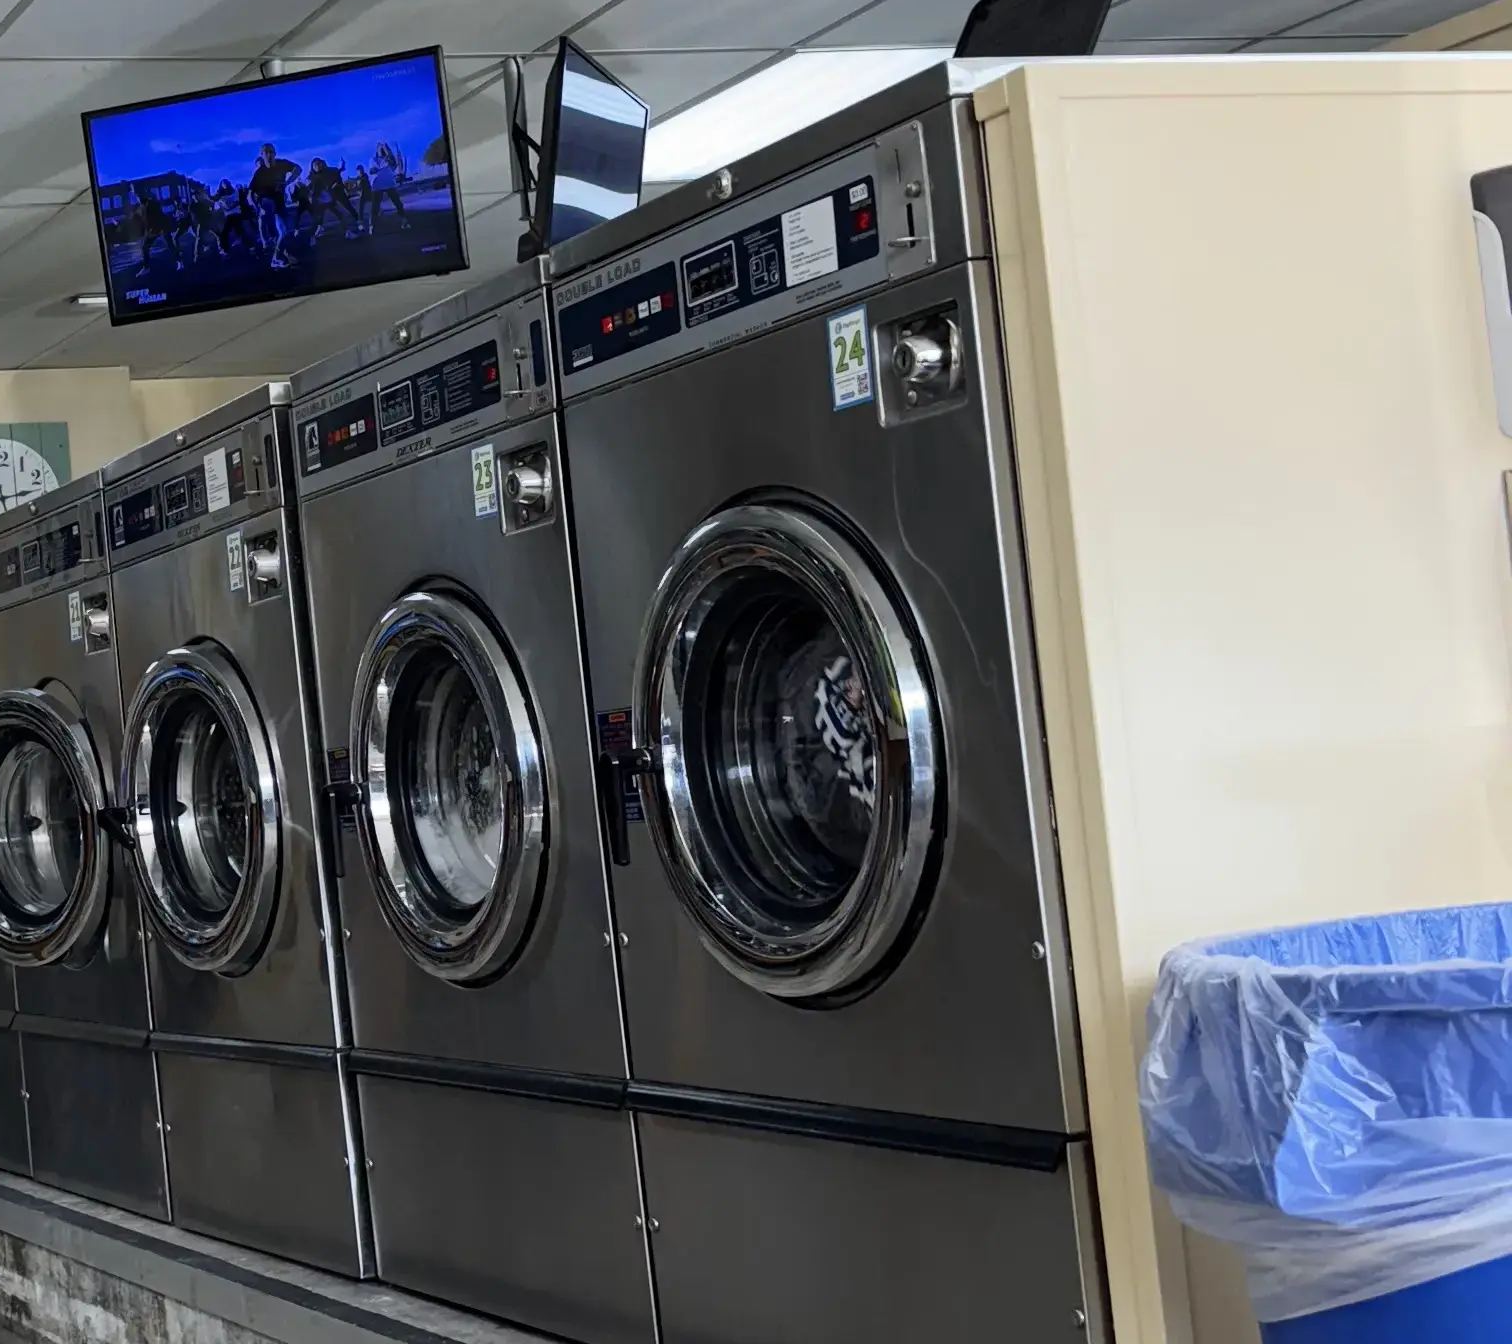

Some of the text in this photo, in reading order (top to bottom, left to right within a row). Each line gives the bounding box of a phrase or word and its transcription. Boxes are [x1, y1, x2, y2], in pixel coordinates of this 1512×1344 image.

[125, 288, 150, 300] SUPER
[556, 258, 641, 307] DOUBLE LOAD
[833, 329, 865, 374] 24
[19, 456, 25, 473] 1
[31, 469, 42, 485] 2
[474, 459, 493, 492] 23
[229, 544, 242, 570] 22
